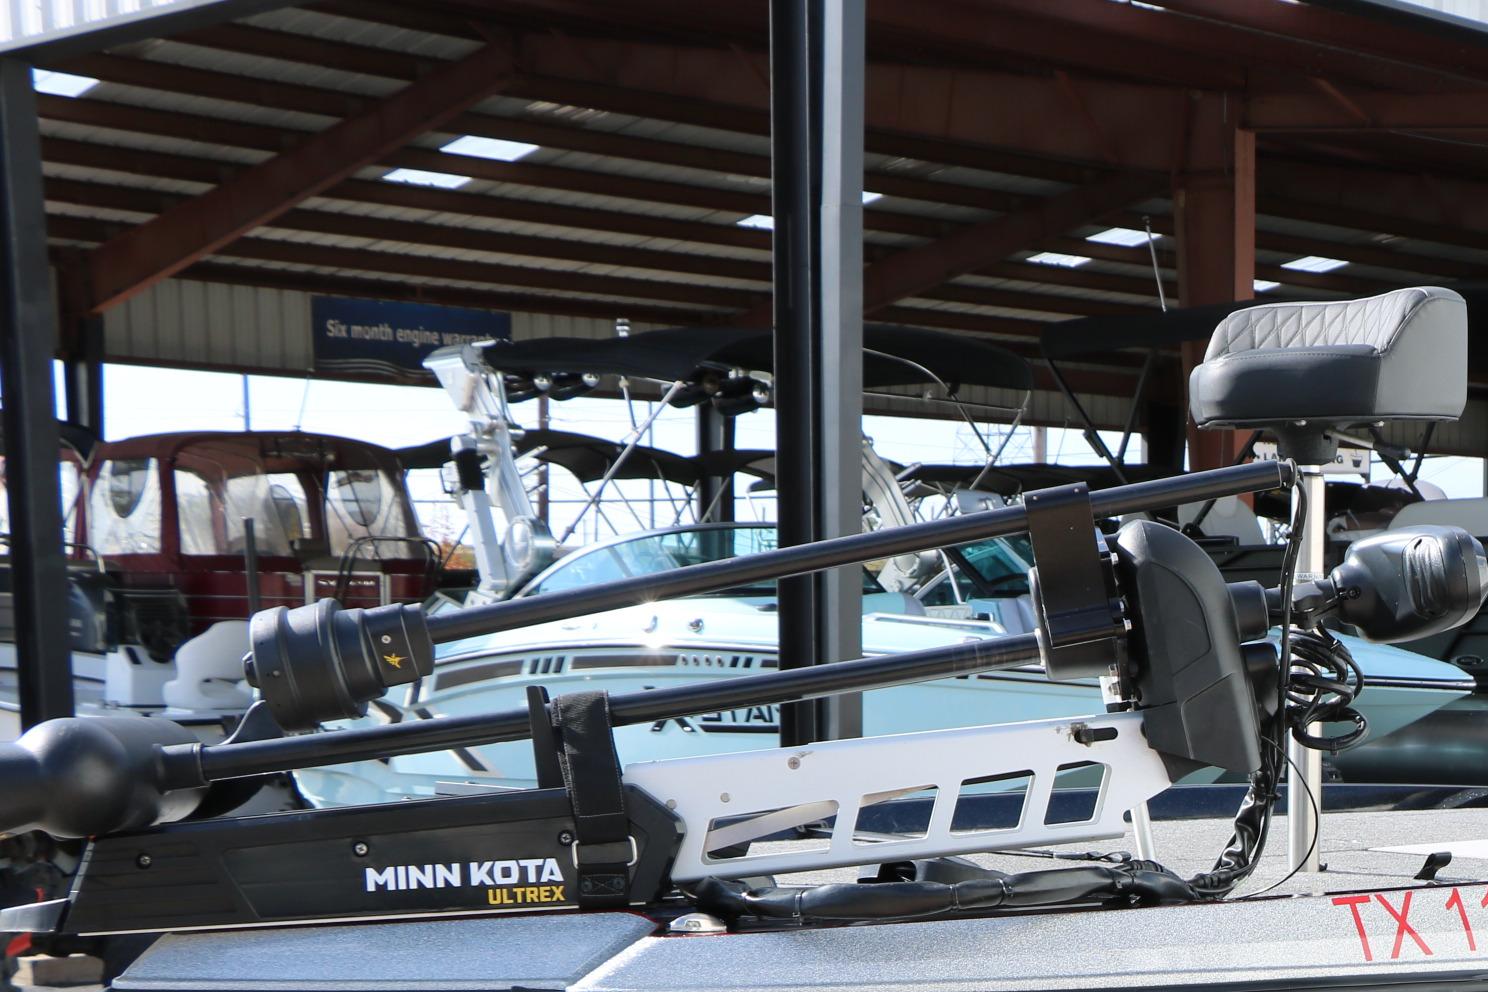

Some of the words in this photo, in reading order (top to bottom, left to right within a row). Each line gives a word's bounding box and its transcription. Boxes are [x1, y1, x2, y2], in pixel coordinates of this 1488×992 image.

[326, 319, 347, 338] Six
[351, 323, 393, 341] month
[395, 326, 439, 347] engine
[365, 863, 461, 892] MINN
[469, 858, 564, 886] KOTA
[488, 886, 565, 905] ULTREX
[1331, 891, 1433, 961] TX
